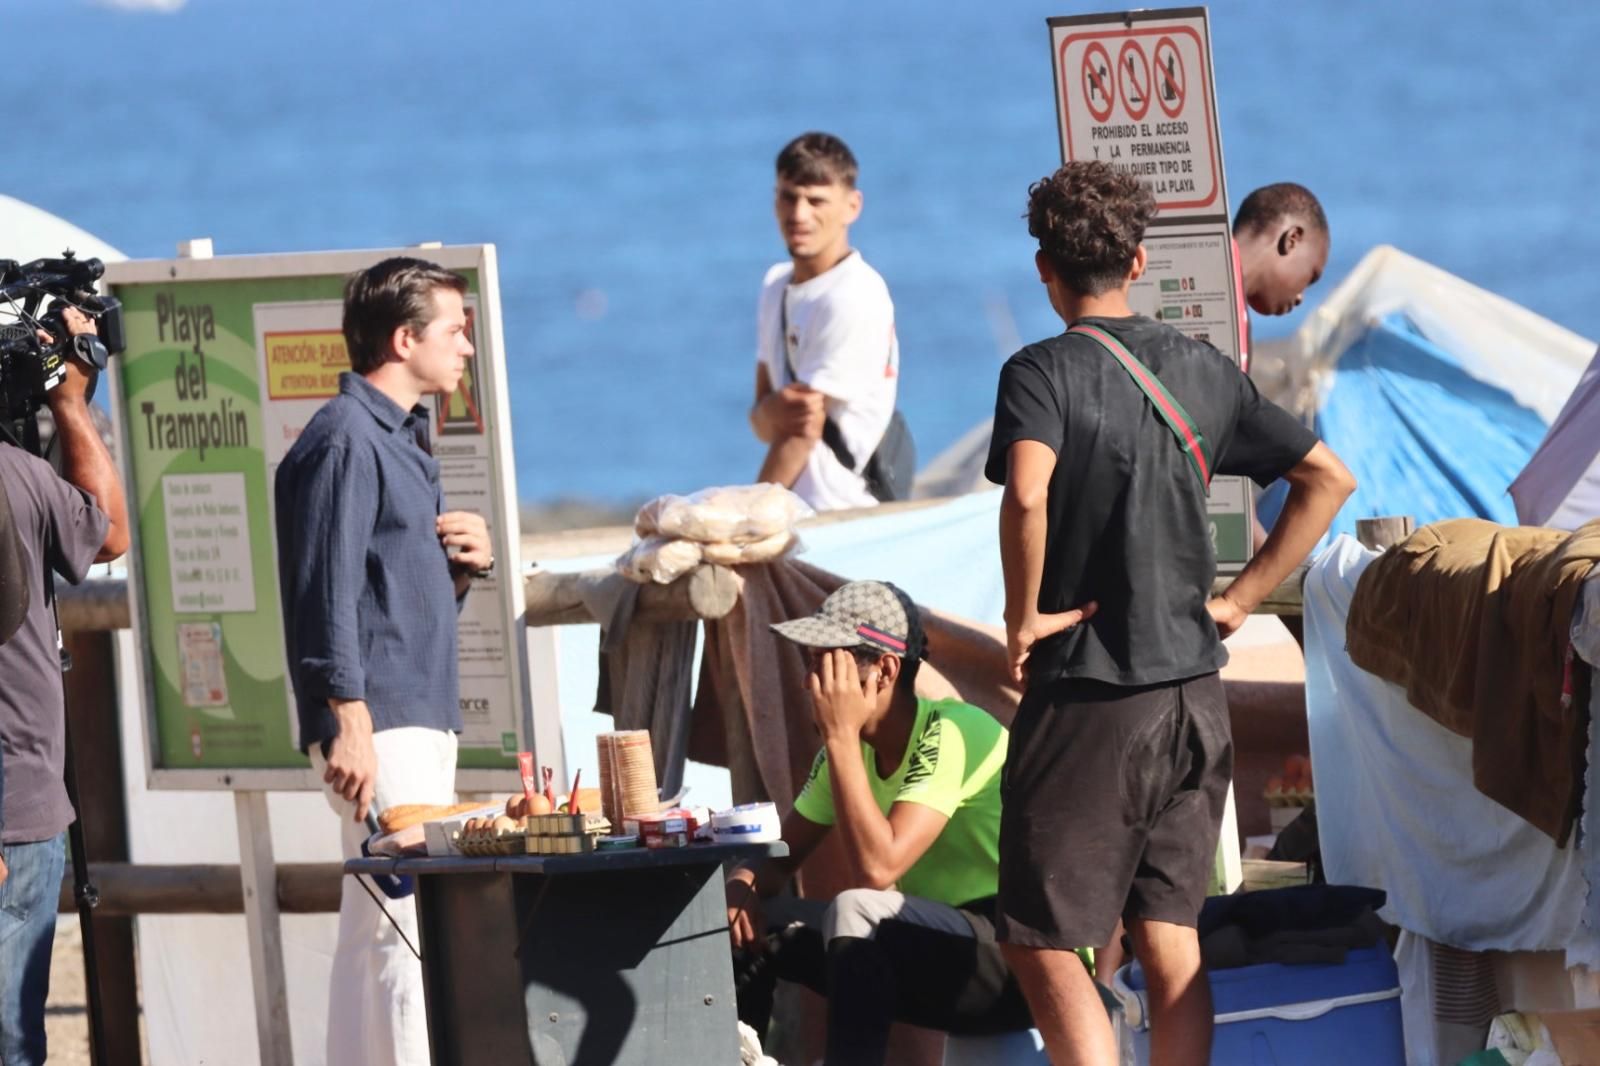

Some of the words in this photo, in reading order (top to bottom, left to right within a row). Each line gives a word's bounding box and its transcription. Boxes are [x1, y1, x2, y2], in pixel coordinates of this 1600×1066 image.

[1091, 124, 1138, 140] PROHIBIDO
[1141, 124, 1152, 137] EL
[1156, 121, 1189, 136] ACCESO
[1093, 145, 1099, 158] Y
[1110, 145, 1121, 158] LA
[1131, 141, 1191, 157] PERMANENCIA
[1112, 161, 1157, 177] UALQUIER
[1159, 160, 1179, 174] TIPO
[1181, 160, 1193, 173] DE
[1155, 181, 1168, 194] LA
[1169, 179, 1195, 193] PLAYA
[156, 292, 216, 354] Playa
[175, 351, 208, 401] del
[141, 398, 249, 462] Trampolín
